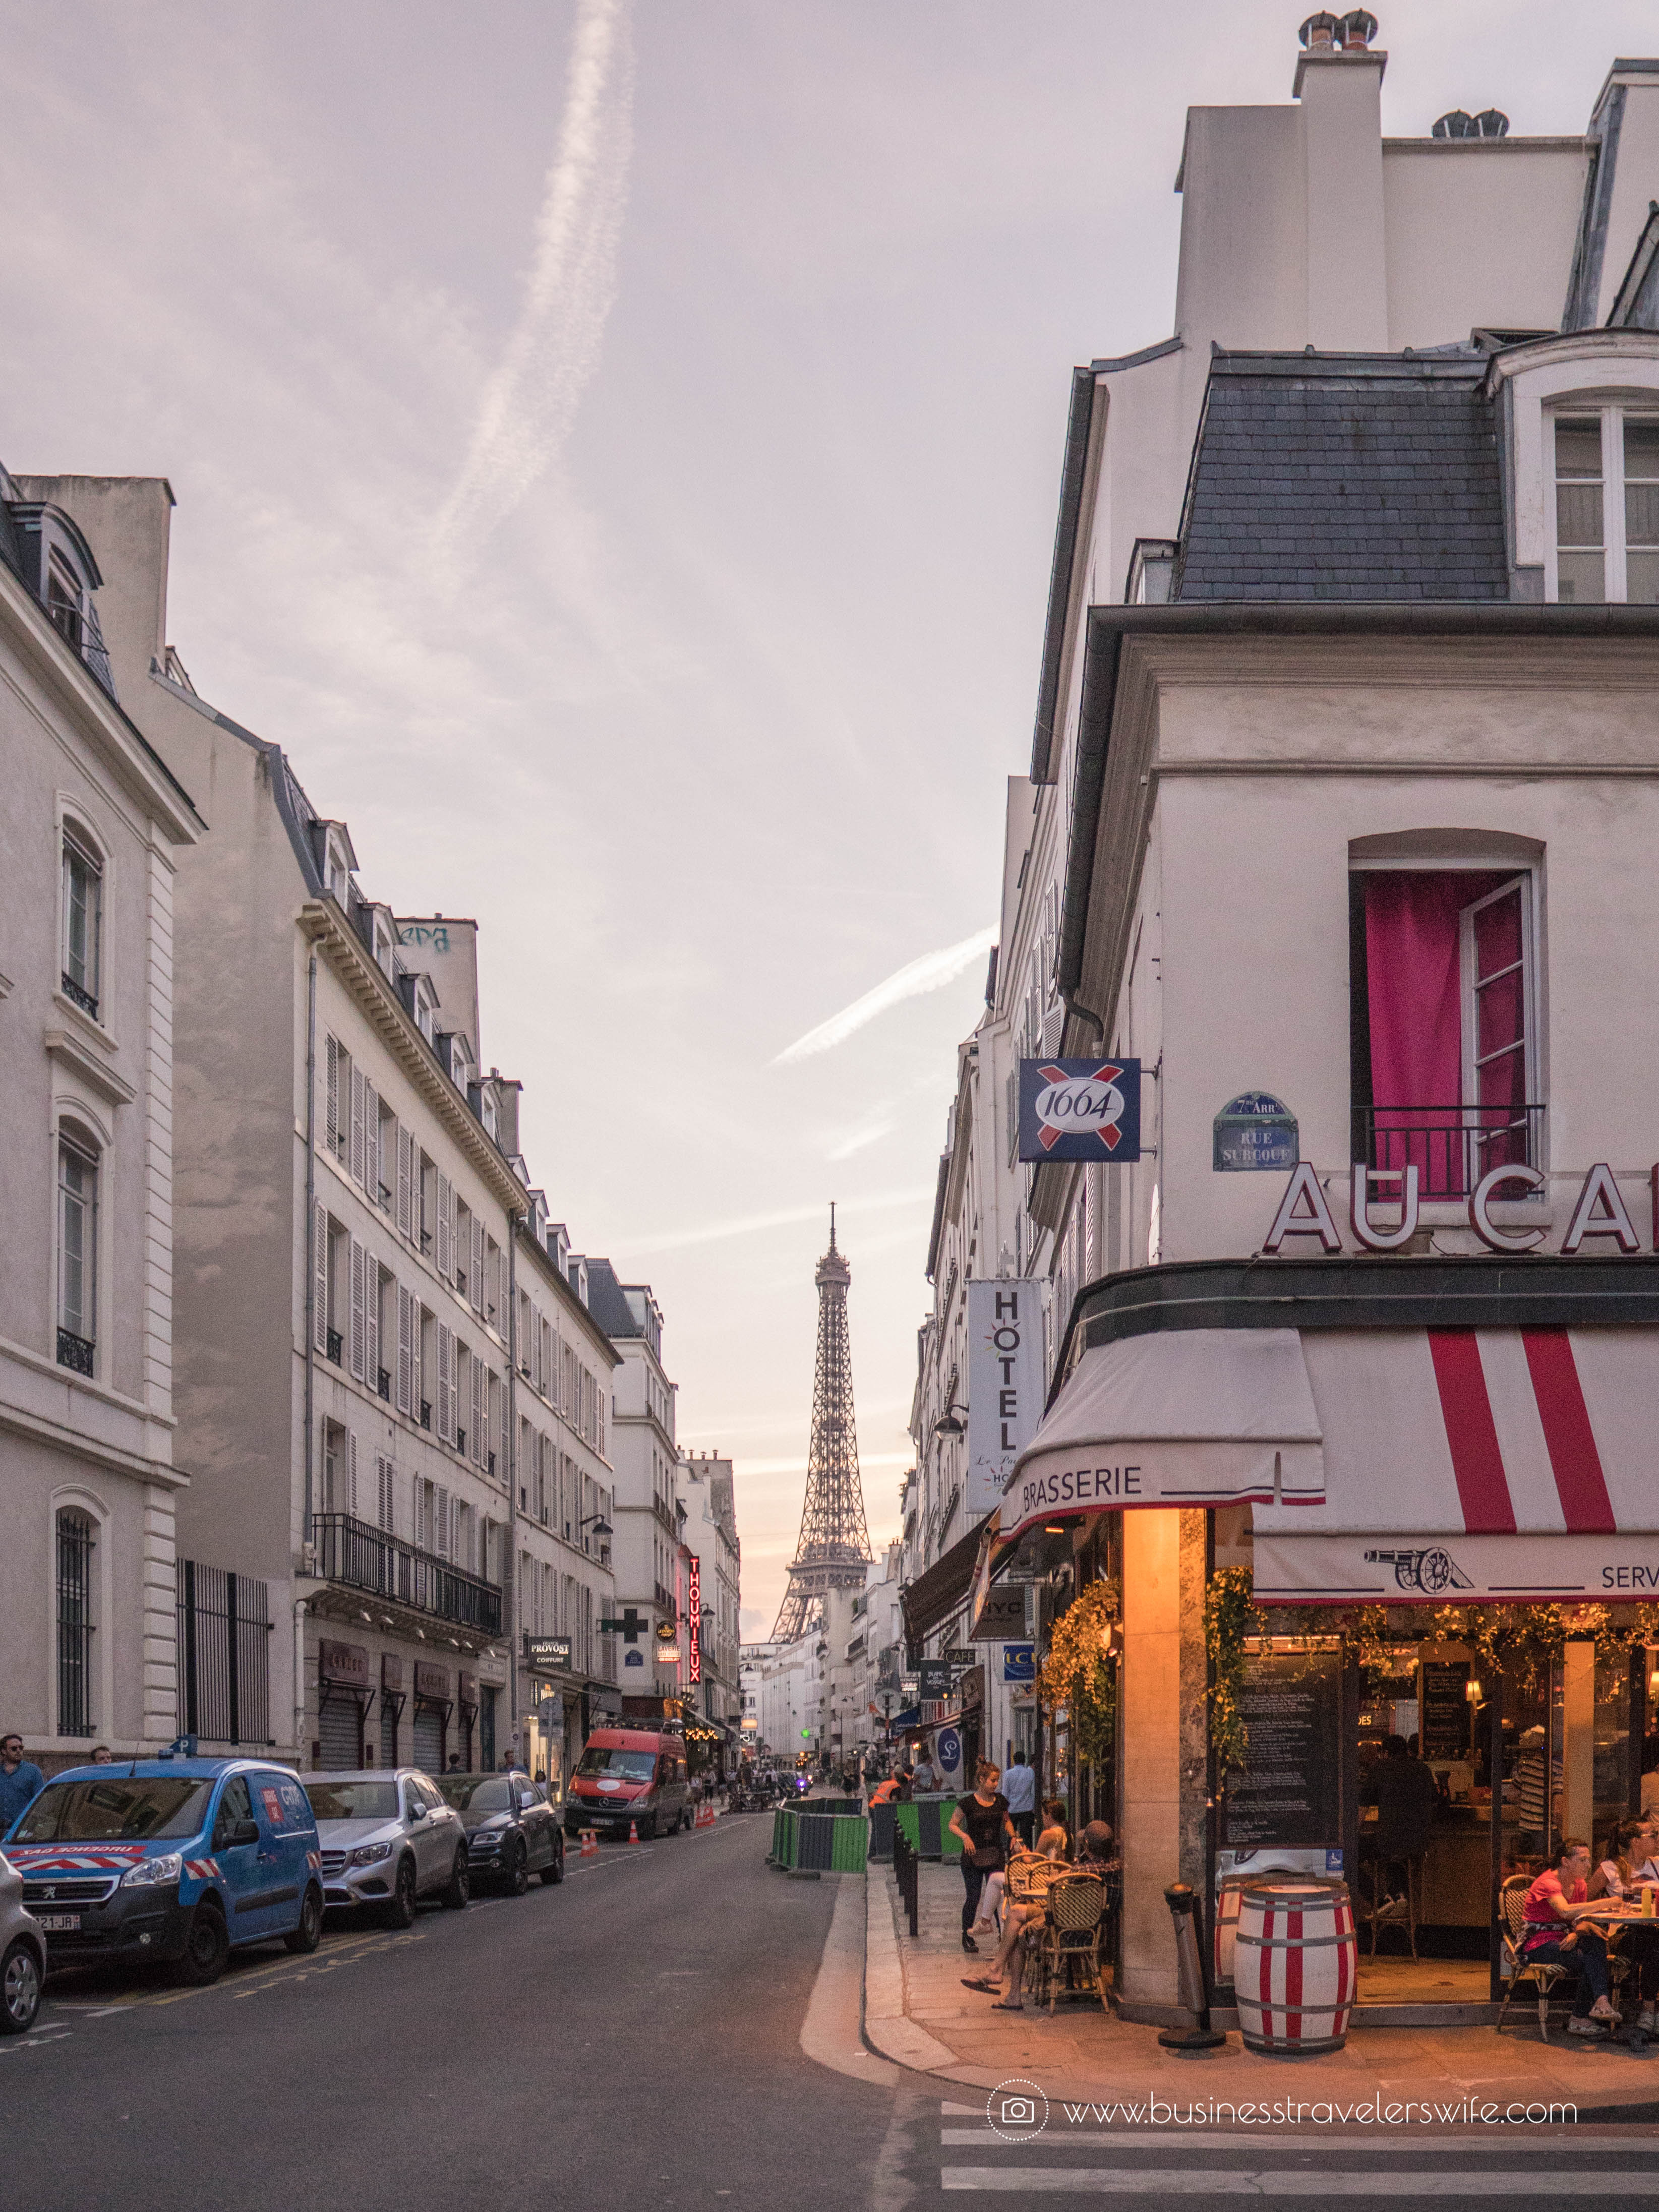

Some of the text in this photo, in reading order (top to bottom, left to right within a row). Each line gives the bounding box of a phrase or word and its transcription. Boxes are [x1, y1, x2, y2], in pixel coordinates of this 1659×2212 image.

[1043, 1086, 1115, 1119] 1664
[1241, 1133, 1273, 1144] RUE
[1223, 1150, 1289, 1161] SURCOUF
[1262, 1161, 1659, 1255] AU CA
[993, 1292, 1020, 1451] HOTEL
[1023, 1467, 1142, 1512] BRASSERIE
[1602, 1567, 1659, 1588] SERV
[689, 1559, 700, 1682] THOUMIEUX
[531, 1645, 569, 1653] PROVOST
[180, 1740, 189, 1752] P
[36, 1917, 72, 1929] 21-JR
